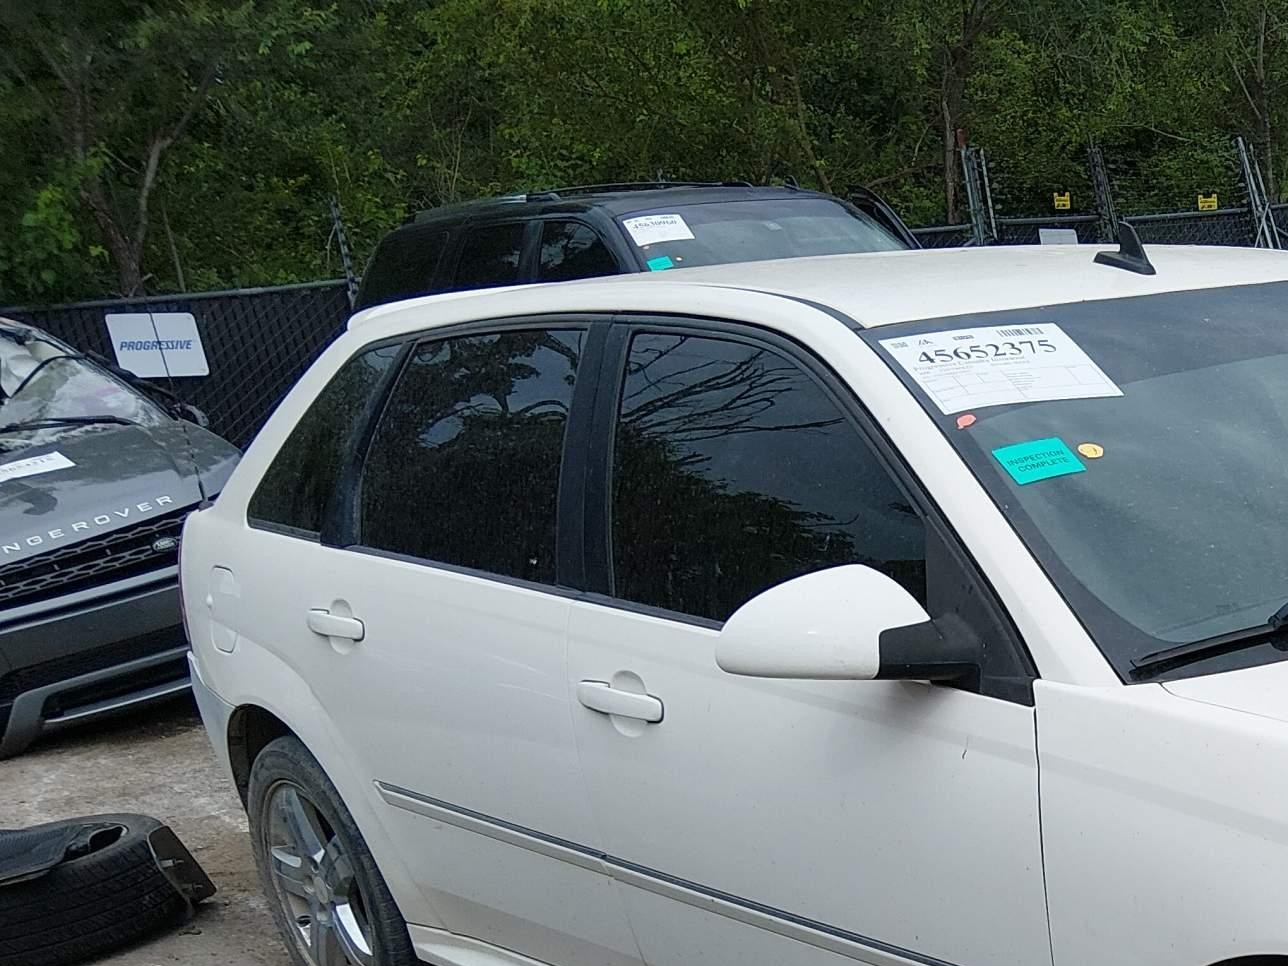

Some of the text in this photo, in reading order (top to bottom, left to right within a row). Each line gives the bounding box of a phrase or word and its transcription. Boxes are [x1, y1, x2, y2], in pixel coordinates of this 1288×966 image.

[119, 339, 193, 351] PROGRESSIVE
[918, 339, 1057, 364] 45652375
[1006, 448, 1065, 467] INSPECTION
[1017, 456, 1071, 473] COMPLETE
